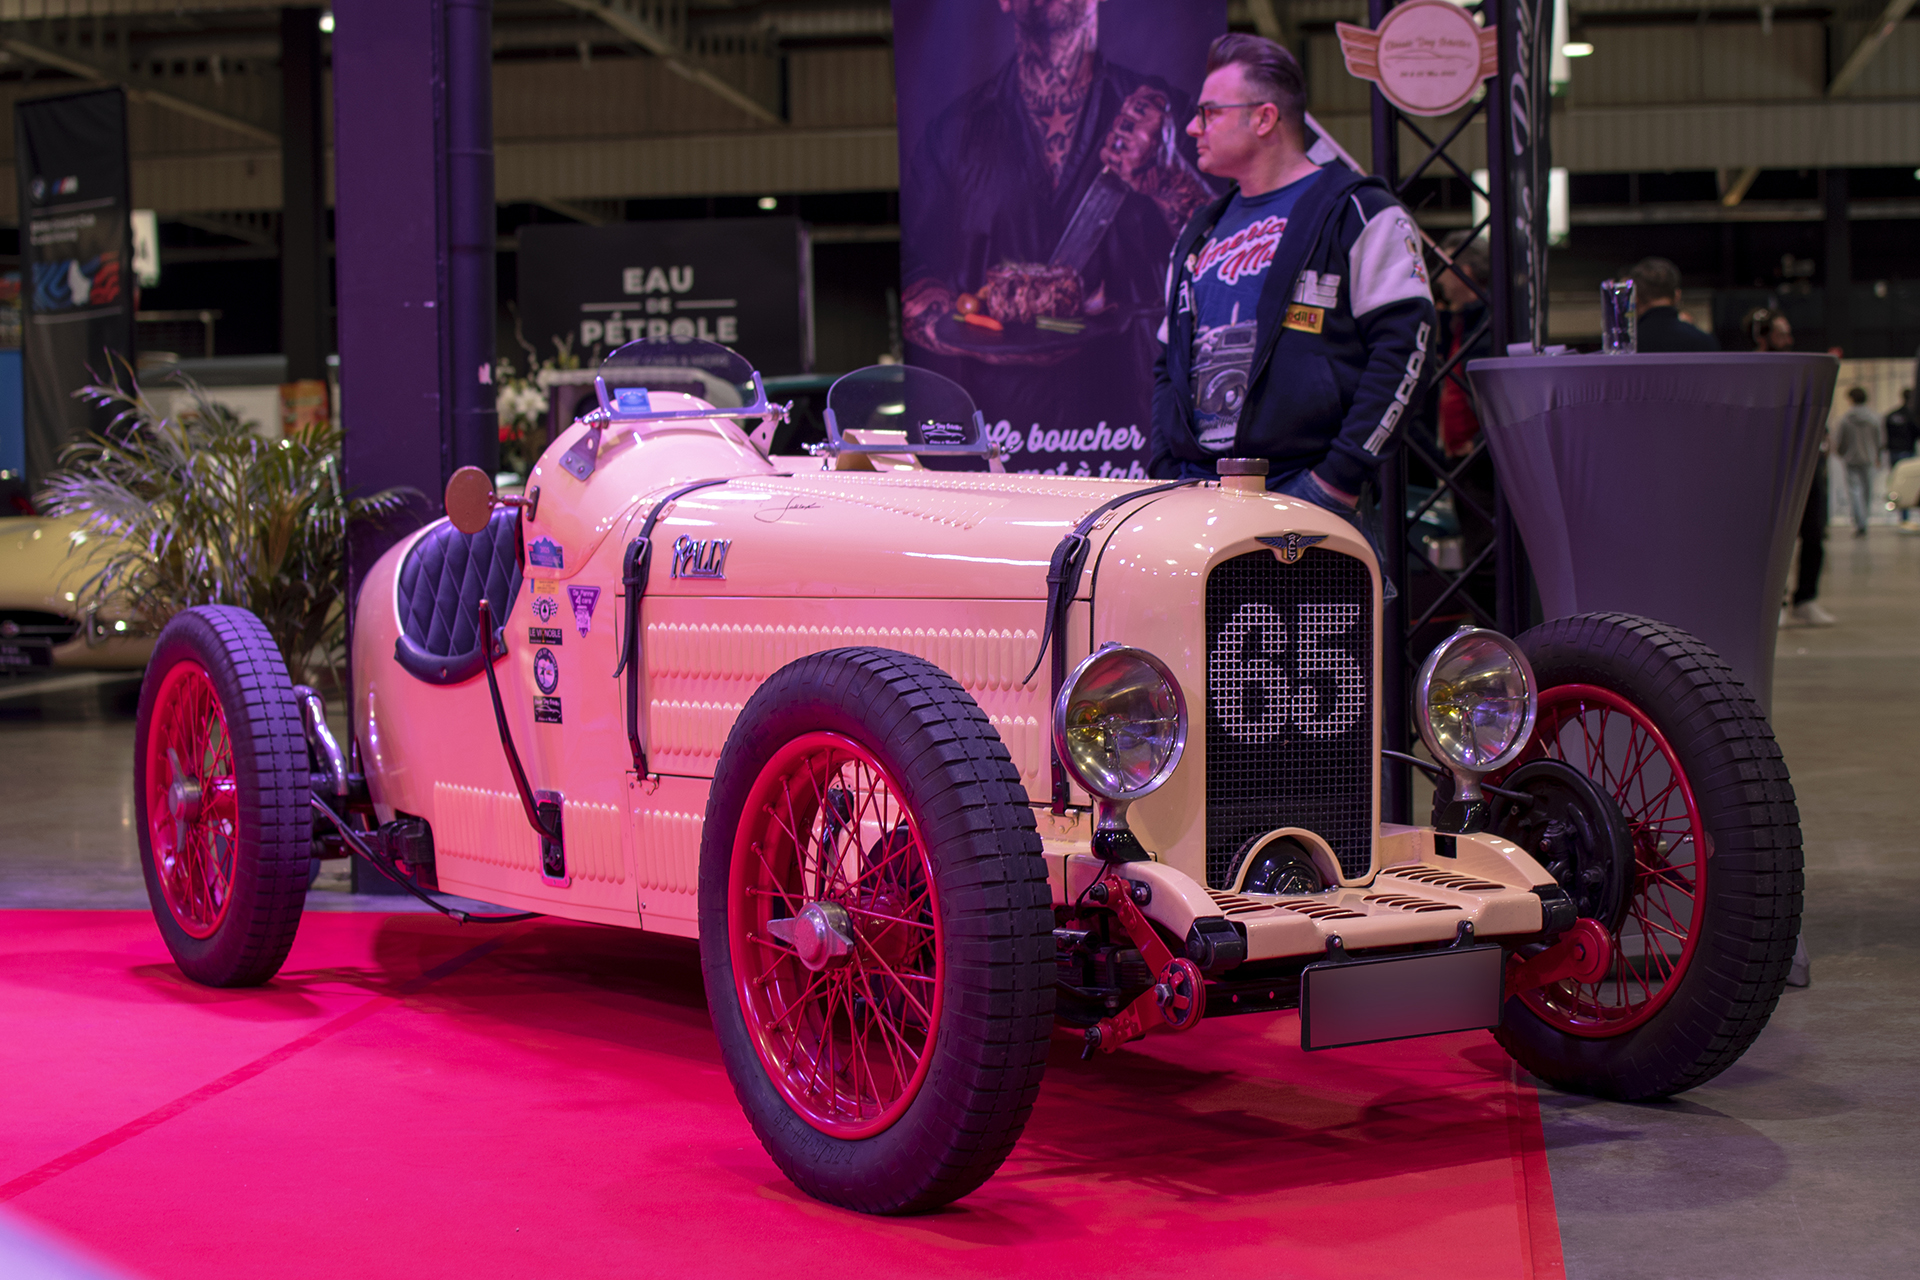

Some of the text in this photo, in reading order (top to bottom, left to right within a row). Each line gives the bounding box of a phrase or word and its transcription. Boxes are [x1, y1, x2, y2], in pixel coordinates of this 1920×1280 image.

[1191, 216, 1288, 283] Americ
[1217, 237, 1281, 286] Mu
[623, 265, 694, 294] EAU
[646, 297, 671, 314] DE
[580, 311, 738, 346] PÉTROLE
[1363, 321, 1431, 456] DODGE
[1026, 421, 1146, 453] boucher
[669, 533, 732, 580] RALLY
[1288, 533, 1297, 560] RALLY
[529, 628, 561, 638] LE VINOBLE
[1210, 603, 1367, 744] 65
